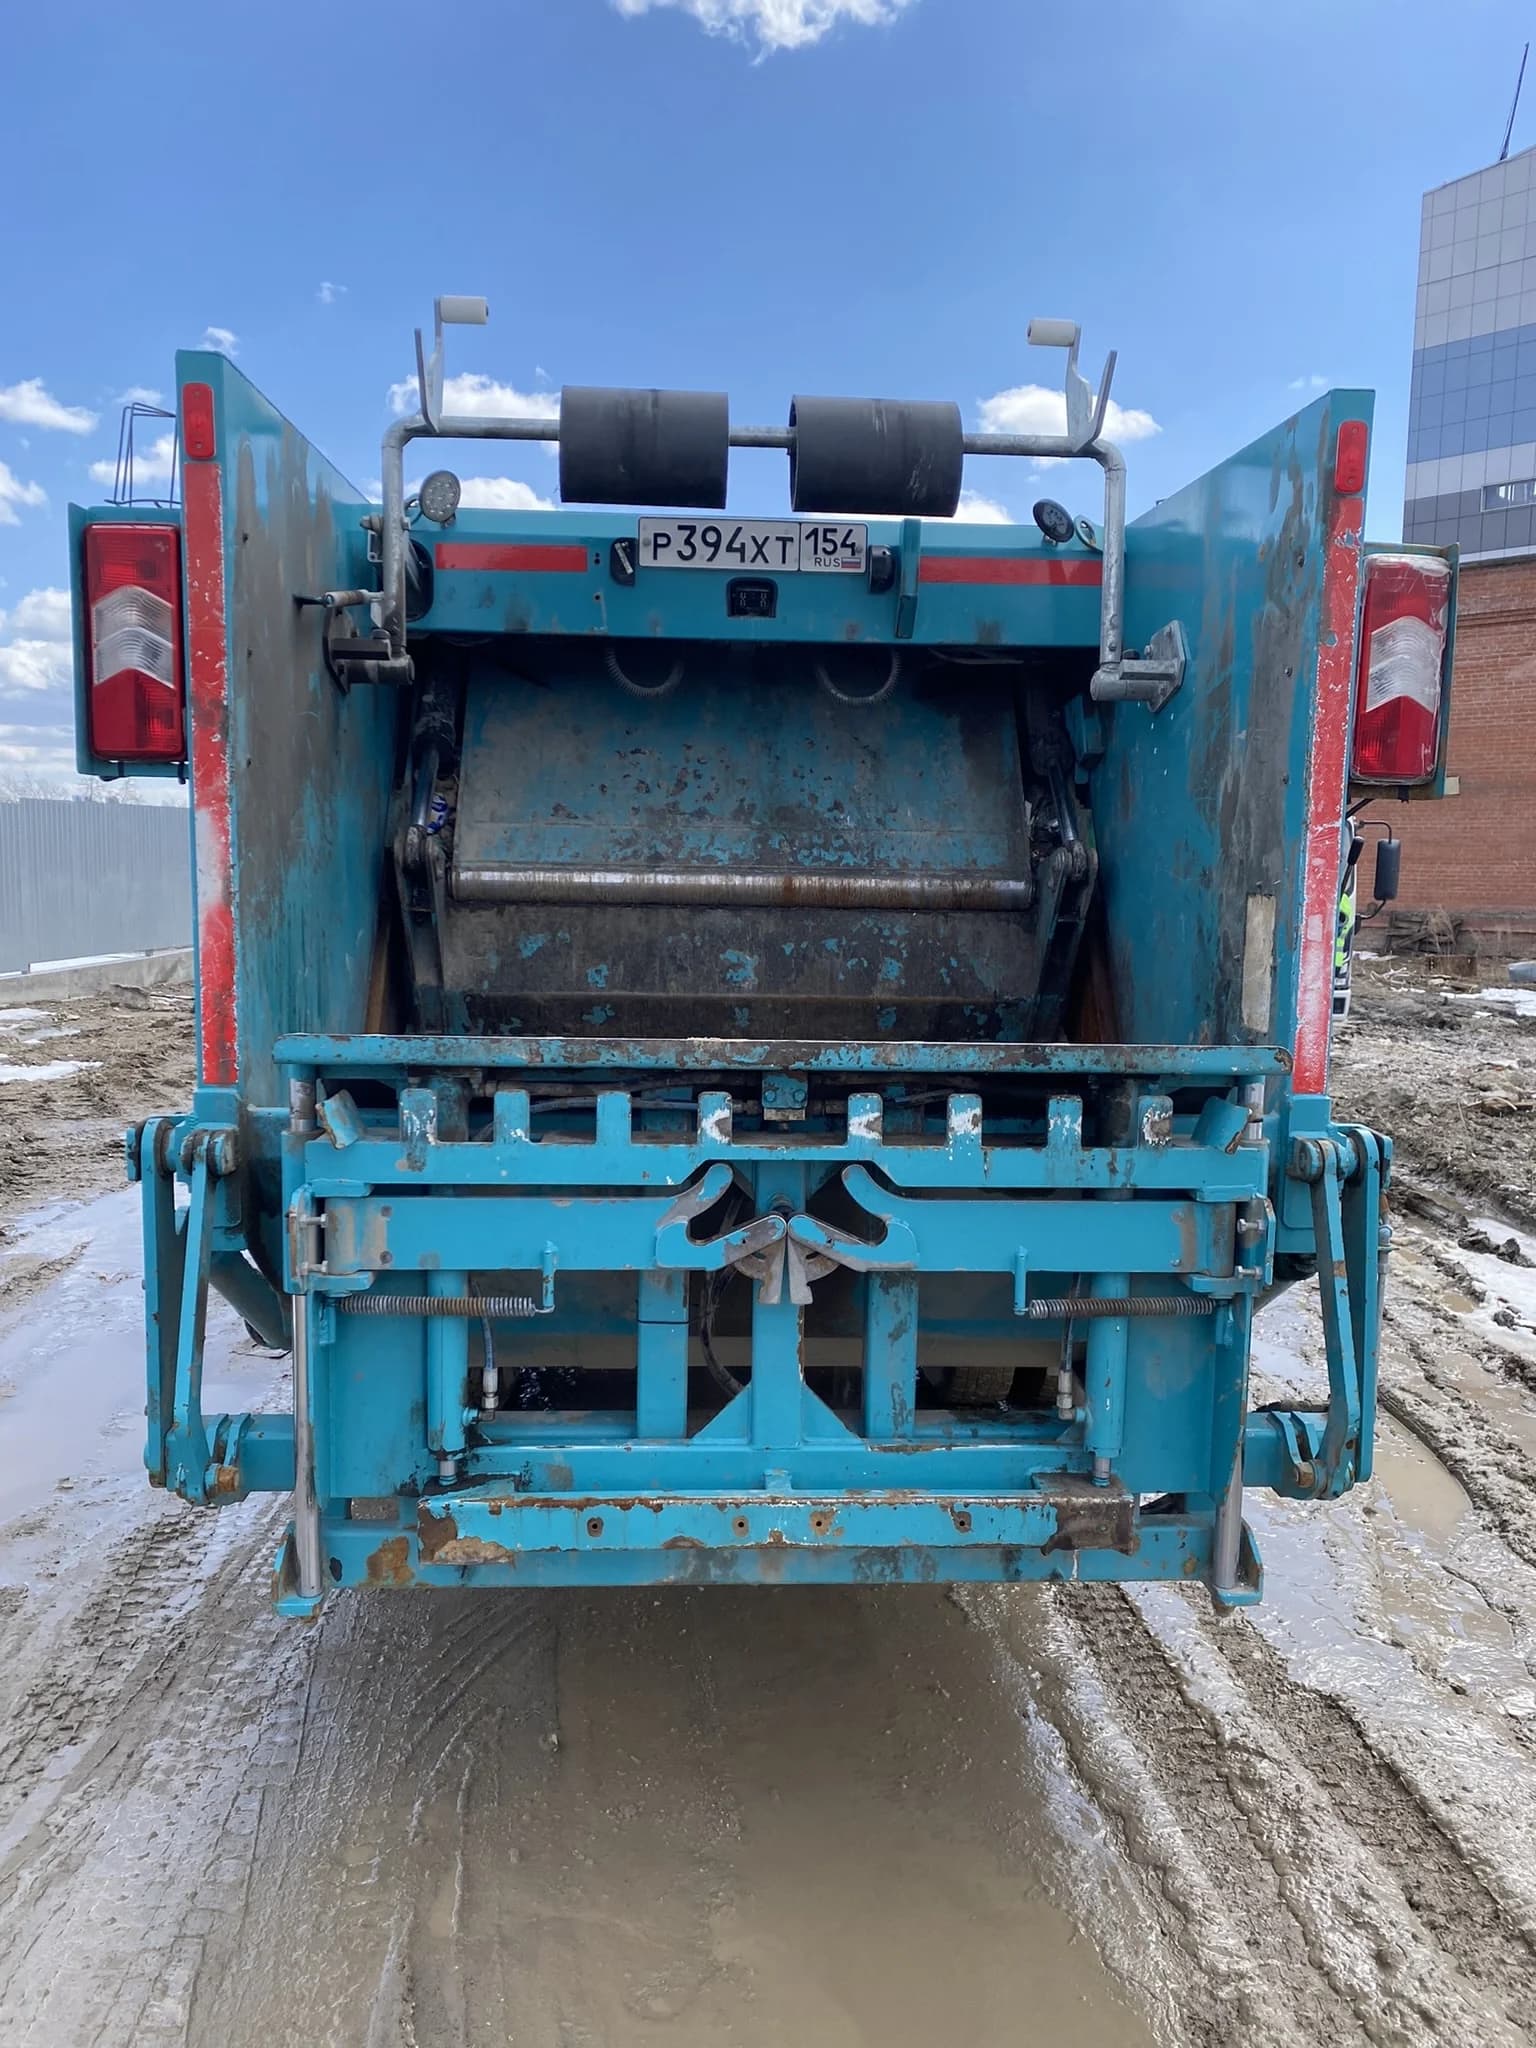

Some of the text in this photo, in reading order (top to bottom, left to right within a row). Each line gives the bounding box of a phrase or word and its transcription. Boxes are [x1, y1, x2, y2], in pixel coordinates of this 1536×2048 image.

[653, 525, 857, 564] Р394ХТ 154
[814, 557, 841, 568] RUS
